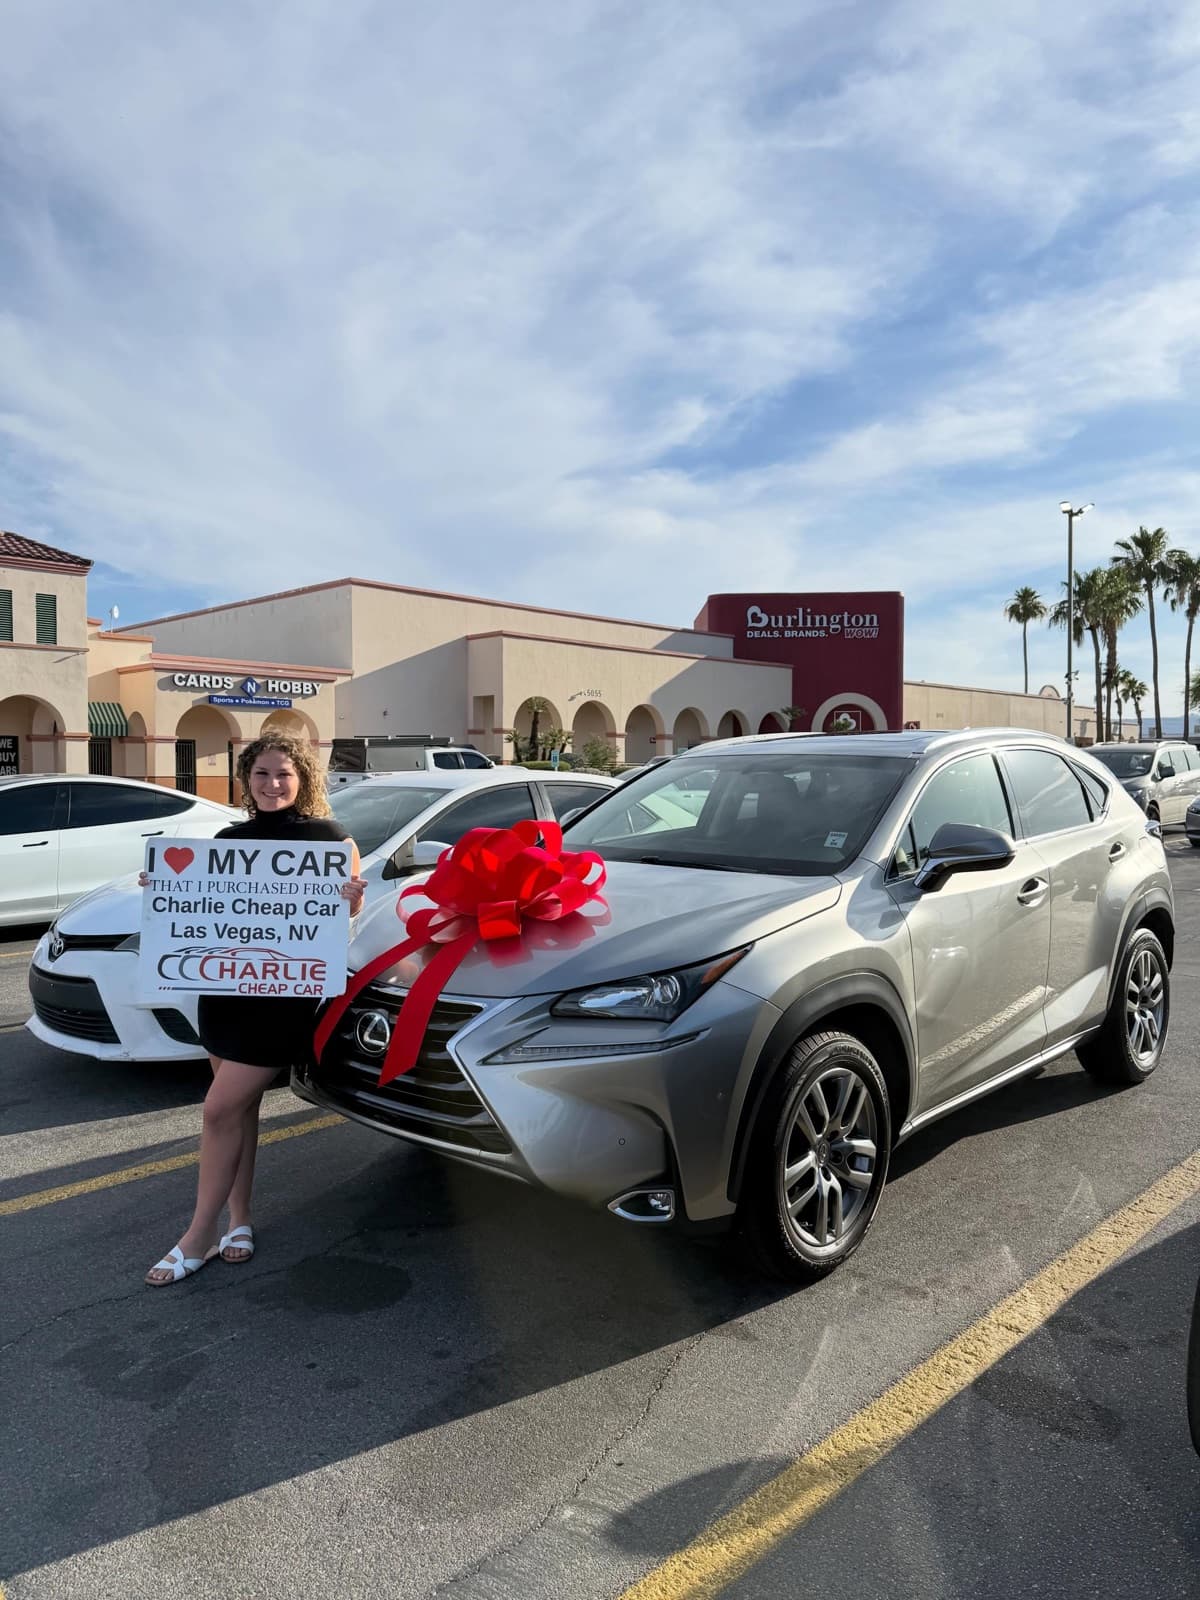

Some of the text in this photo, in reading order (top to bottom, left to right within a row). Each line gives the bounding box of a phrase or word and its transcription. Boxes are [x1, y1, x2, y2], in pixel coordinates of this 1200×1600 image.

[747, 605, 879, 634] Burlington
[747, 627, 879, 639] DEALS. BRANDS. WOW!
[174, 673, 322, 695] CARDS N HOBBY
[213, 696, 234, 704] Sports
[0, 765, 17, 777] ARS
[148, 847, 347, 877] I MY CAR
[150, 880, 193, 892] THAT
[198, 880, 202, 893] I
[207, 881, 299, 895] PURCHASED
[152, 896, 340, 920] Charlie Cheap Car
[171, 922, 319, 944] Las Vegas, NV
[238, 983, 324, 995] CHEAP CAR
